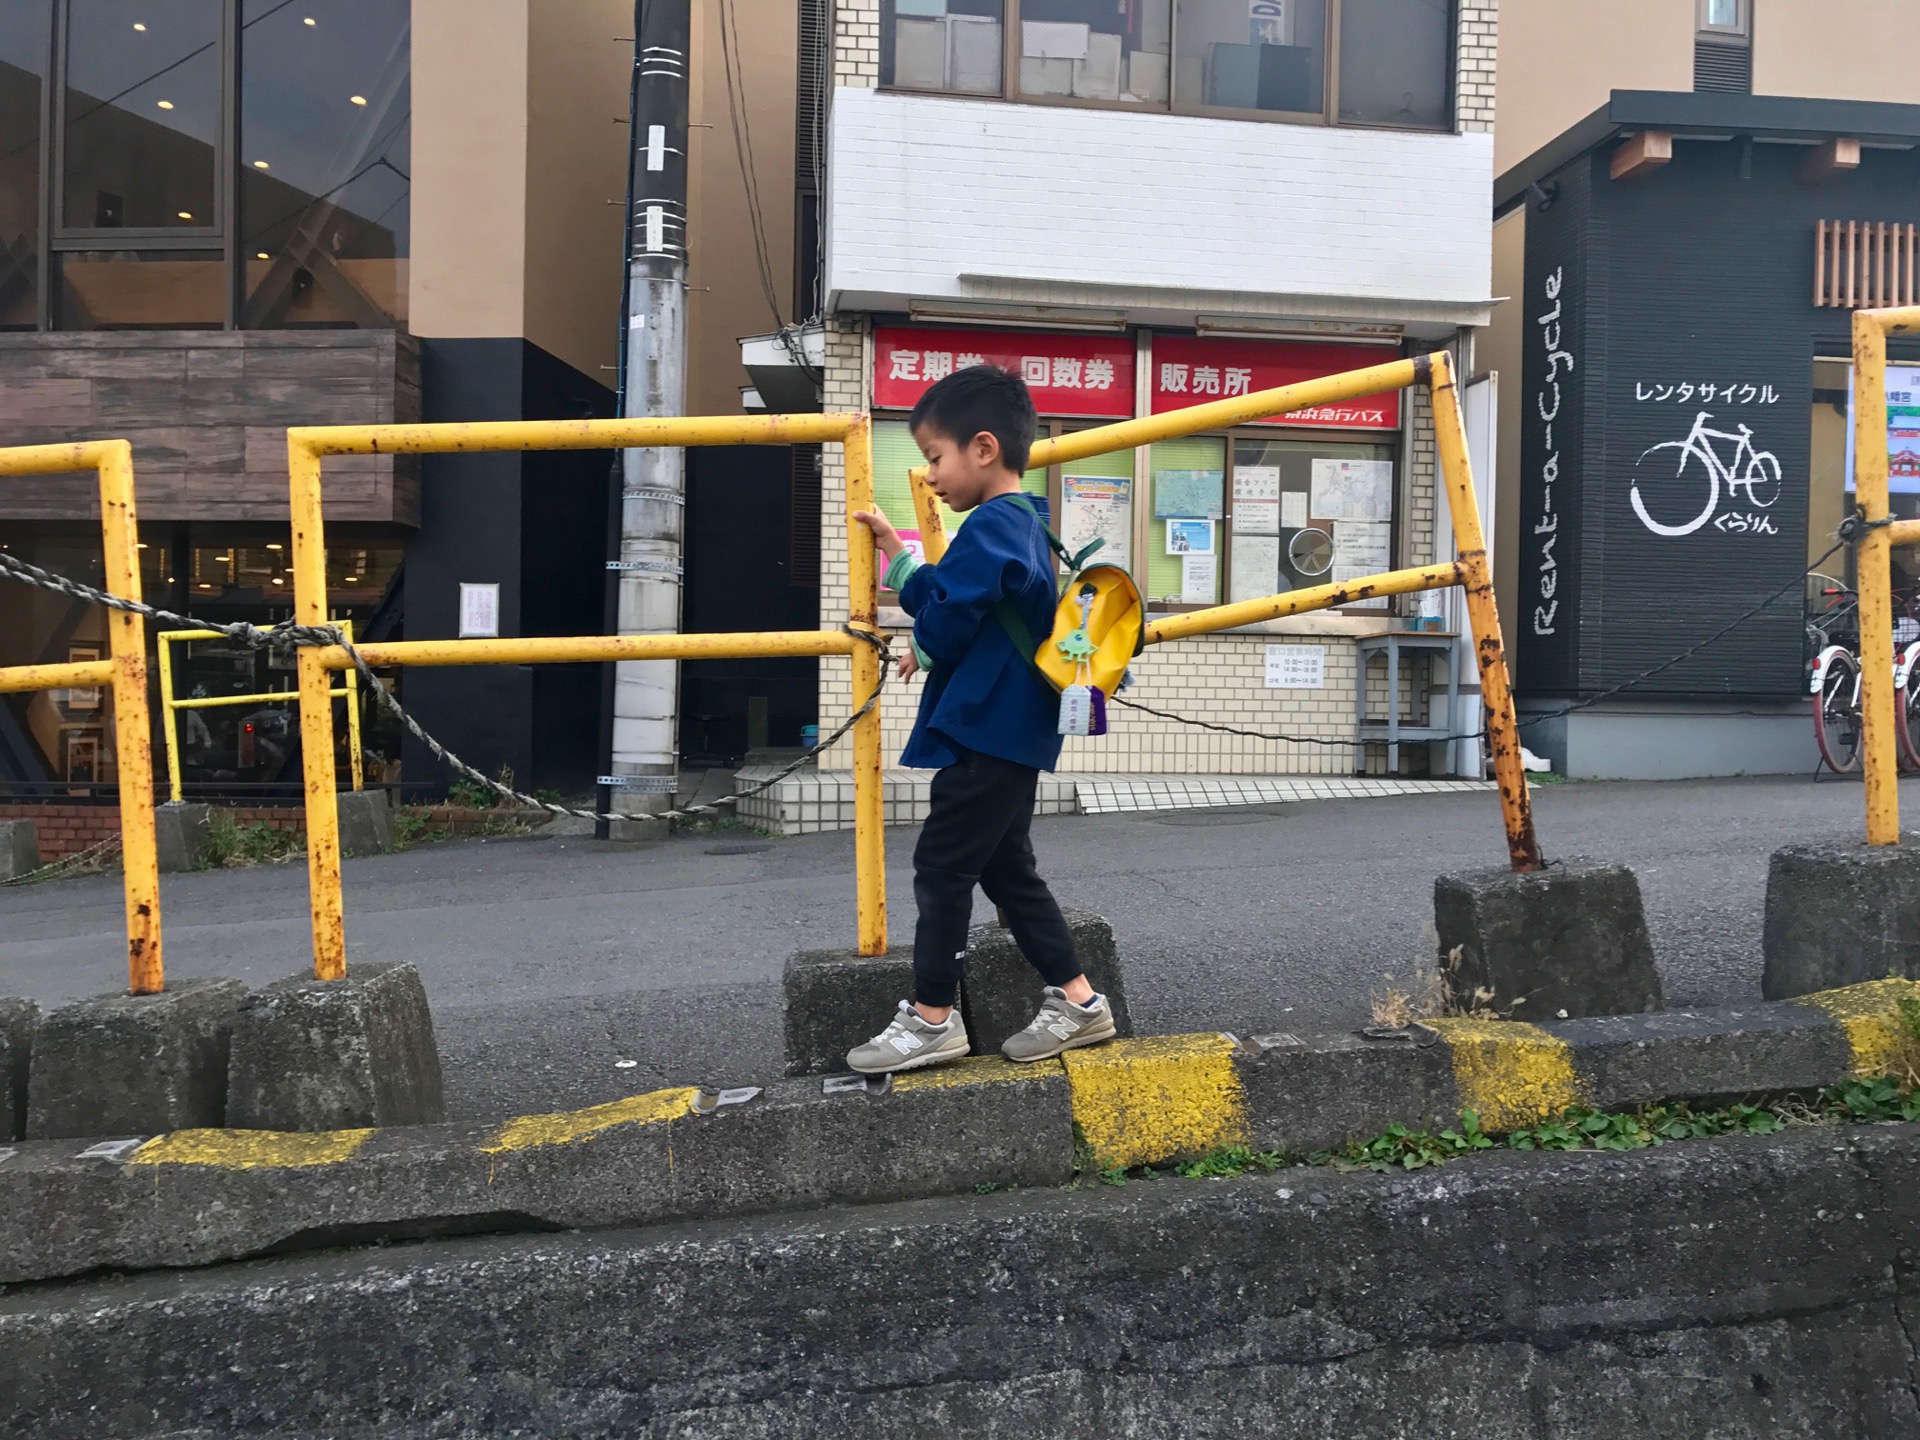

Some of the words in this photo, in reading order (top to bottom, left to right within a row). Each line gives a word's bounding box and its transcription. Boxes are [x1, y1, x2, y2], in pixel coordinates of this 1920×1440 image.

[1252, 0, 1282, 16] D
[1160, 363, 1252, 396] 販売所
[1635, 381, 1780, 404] レンタサイクル
[1534, 265, 1573, 636] Rent-a-Cycle
[1714, 512, 1779, 535] くらりん
